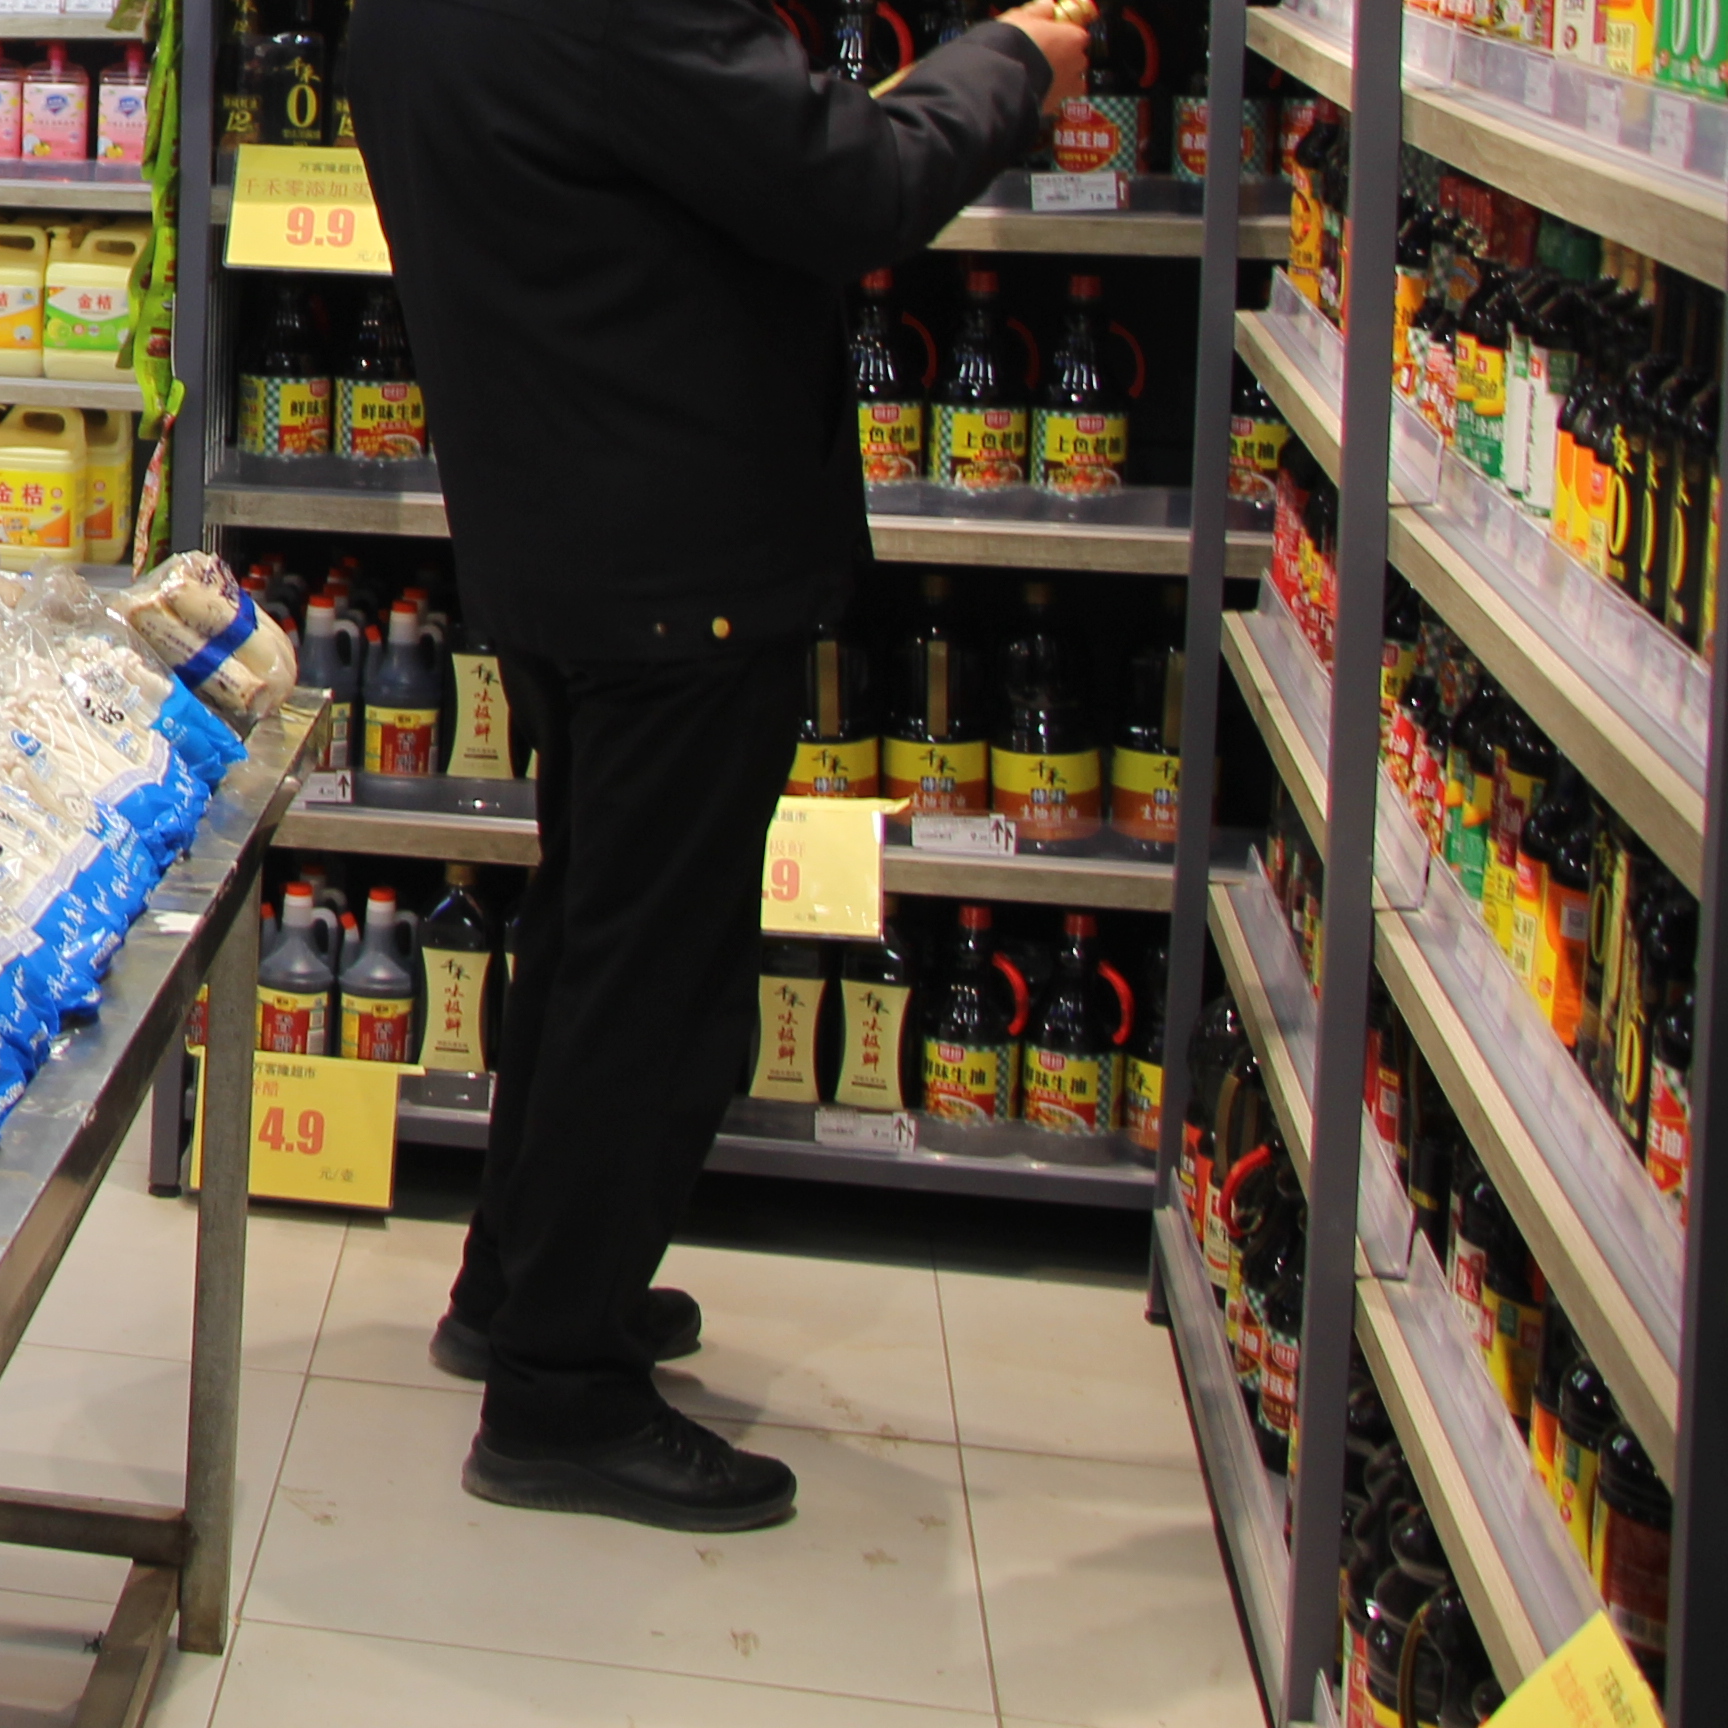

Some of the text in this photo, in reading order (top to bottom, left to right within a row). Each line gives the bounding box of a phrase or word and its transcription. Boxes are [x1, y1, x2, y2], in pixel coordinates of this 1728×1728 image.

[286, 83, 318, 128] 0
[286, 206, 355, 248] 9.9
[78, 293, 112, 311] 金桔
[361, 402, 422, 420] 鲜味生抽
[472, 690, 495, 744] 味极鲜
[1020, 804, 1078, 822] 生抽酱油
[443, 984, 465, 1038] 味极鲜
[776, 1010, 797, 1065] 味极鲜
[861, 1017, 882, 1073] 味极鲜
[257, 1106, 325, 1156] 4.9
